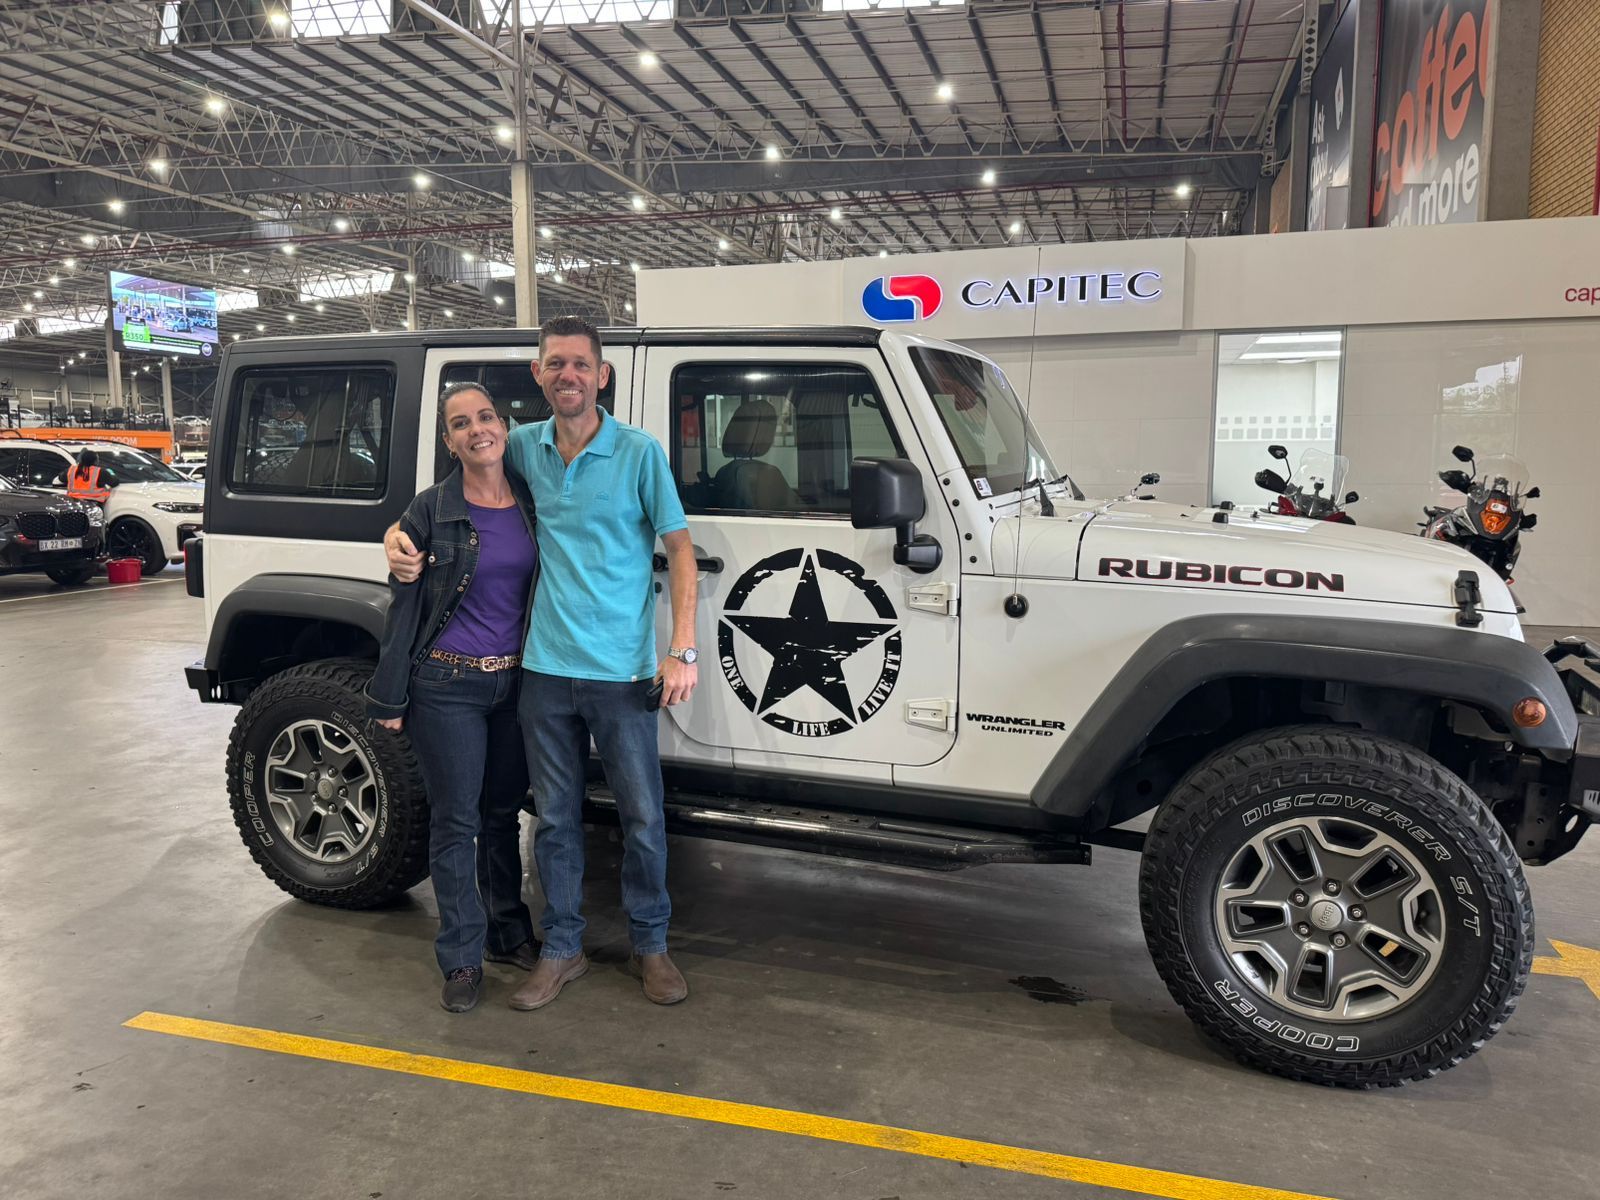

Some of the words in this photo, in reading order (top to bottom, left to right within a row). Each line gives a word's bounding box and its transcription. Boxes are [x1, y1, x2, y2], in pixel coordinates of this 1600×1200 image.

[1311, 100, 1326, 145] Ask
[1310, 143, 1329, 191] about
[1418, 143, 1480, 227] more
[961, 271, 1161, 307] CAPITEC
[1098, 557, 1345, 593] RUBICON
[721, 655, 744, 691] ONE
[792, 721, 831, 736] LIFE
[860, 678, 893, 716] LIVE
[885, 651, 901, 672] IT
[966, 713, 1066, 731] WRANGLER
[981, 724, 1054, 737] UNLIMITED
[330, 711, 389, 838] DISCOVERER
[243, 751, 274, 847] COOPER
[355, 842, 379, 876] S/T
[1242, 793, 1451, 864] DISCOVERER
[1449, 875, 1481, 937] S/T
[1213, 978, 1360, 1053] COOPER
